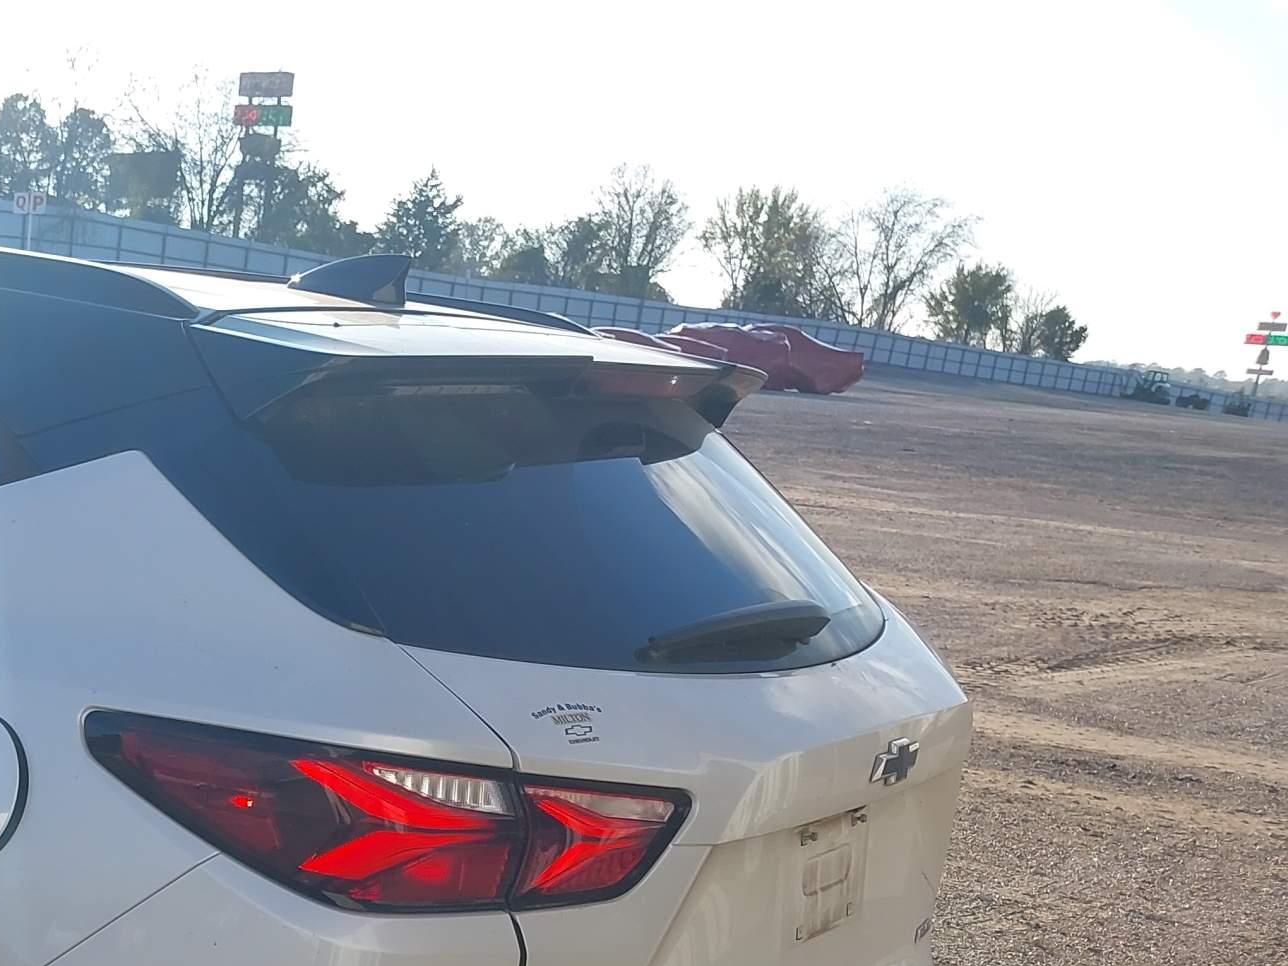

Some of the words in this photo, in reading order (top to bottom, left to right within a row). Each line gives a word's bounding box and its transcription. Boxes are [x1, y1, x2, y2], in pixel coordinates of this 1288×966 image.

[33, 195, 44, 211] P
[531, 705, 557, 720] Sandy
[556, 703, 566, 711] &
[565, 702, 602, 713] Bubba's
[551, 712, 592, 725] MILTON
